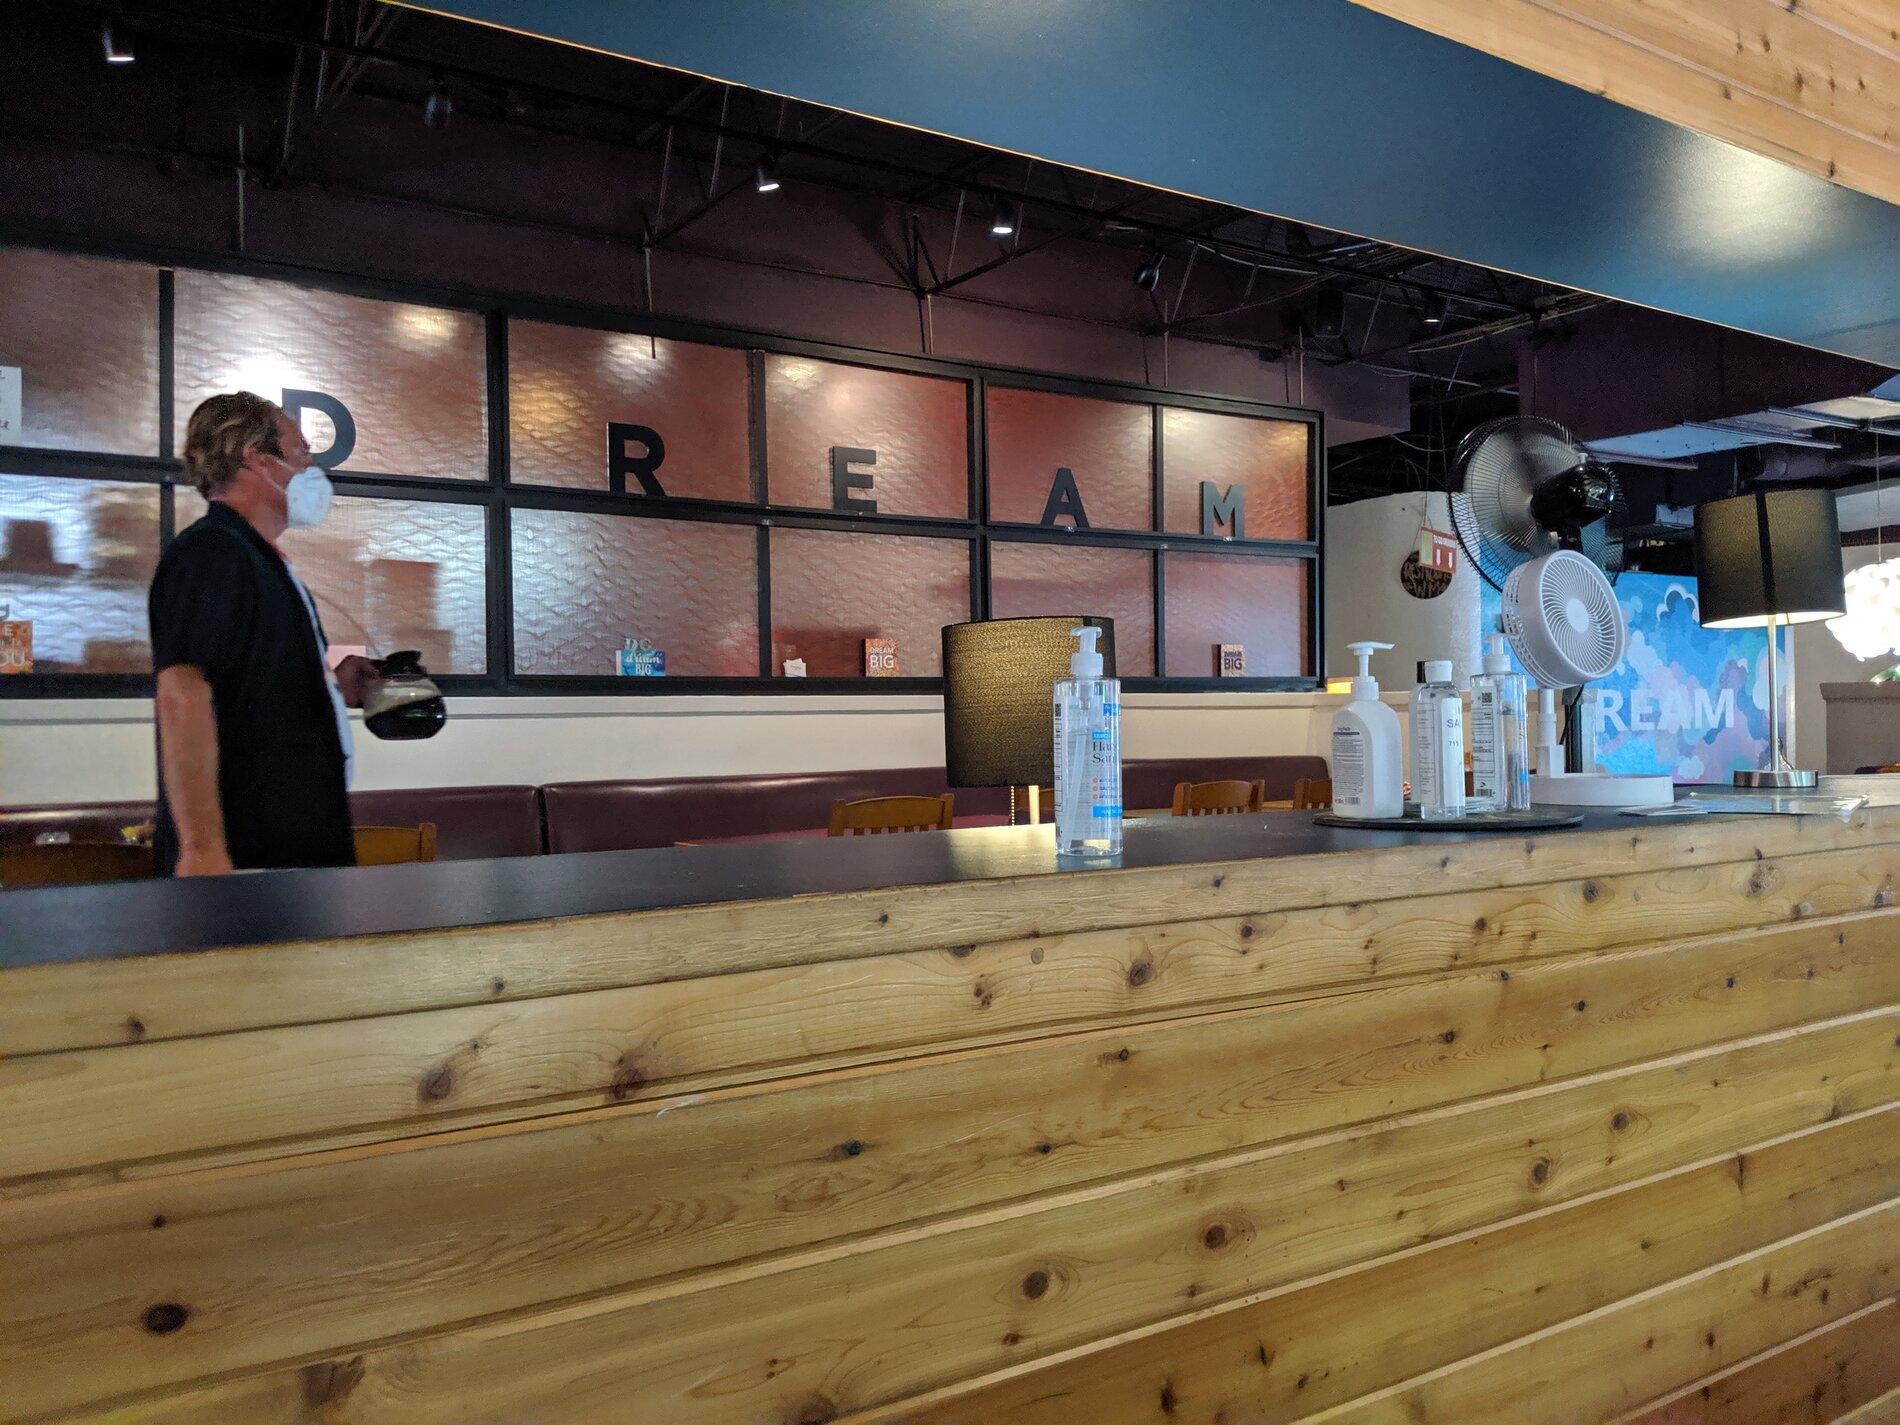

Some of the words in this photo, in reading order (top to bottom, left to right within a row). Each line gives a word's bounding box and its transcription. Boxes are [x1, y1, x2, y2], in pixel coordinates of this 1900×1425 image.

[869, 655, 894, 668] BIG
[1223, 658, 1242, 669] BIG
[635, 663, 651, 676] BIG
[1595, 687, 1735, 733] REAM
